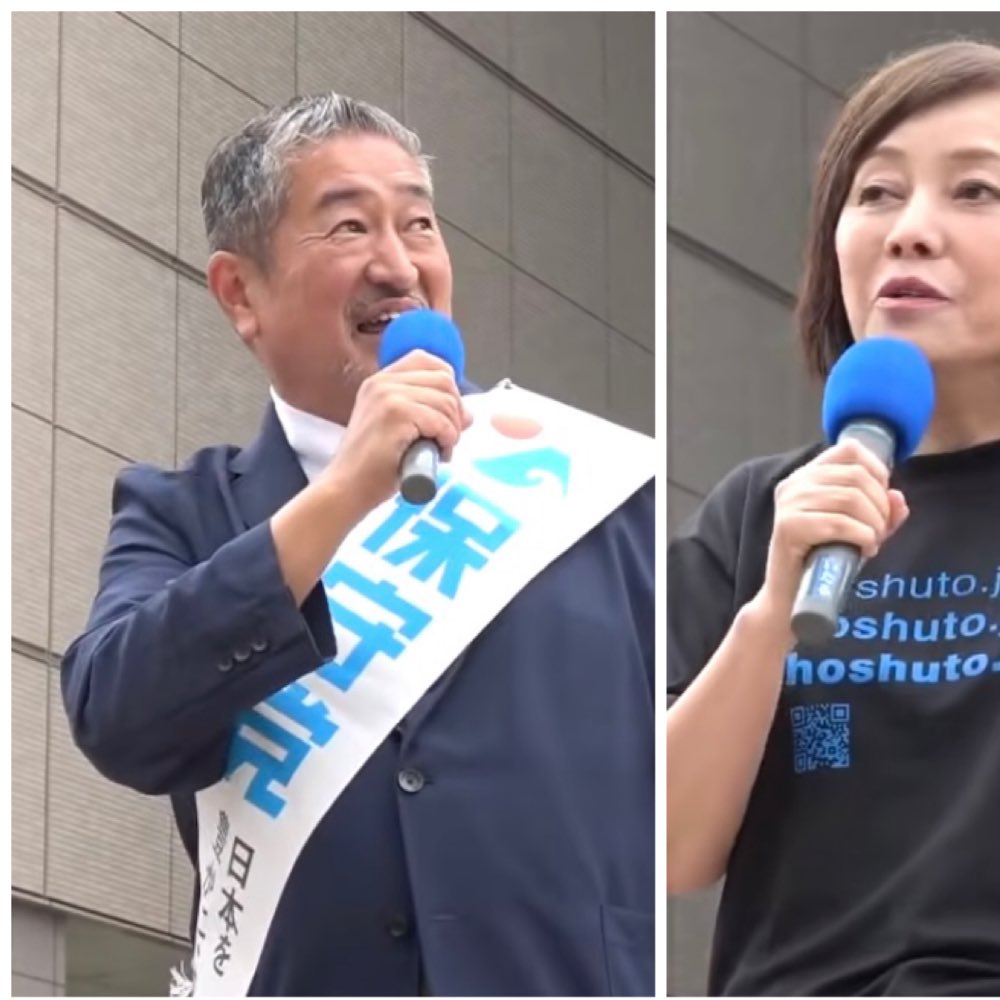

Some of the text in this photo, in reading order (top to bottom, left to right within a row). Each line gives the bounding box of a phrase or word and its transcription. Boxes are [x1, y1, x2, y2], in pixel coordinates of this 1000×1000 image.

[223, 478, 524, 818] 保守党
[213, 836, 255, 977] 日本を
